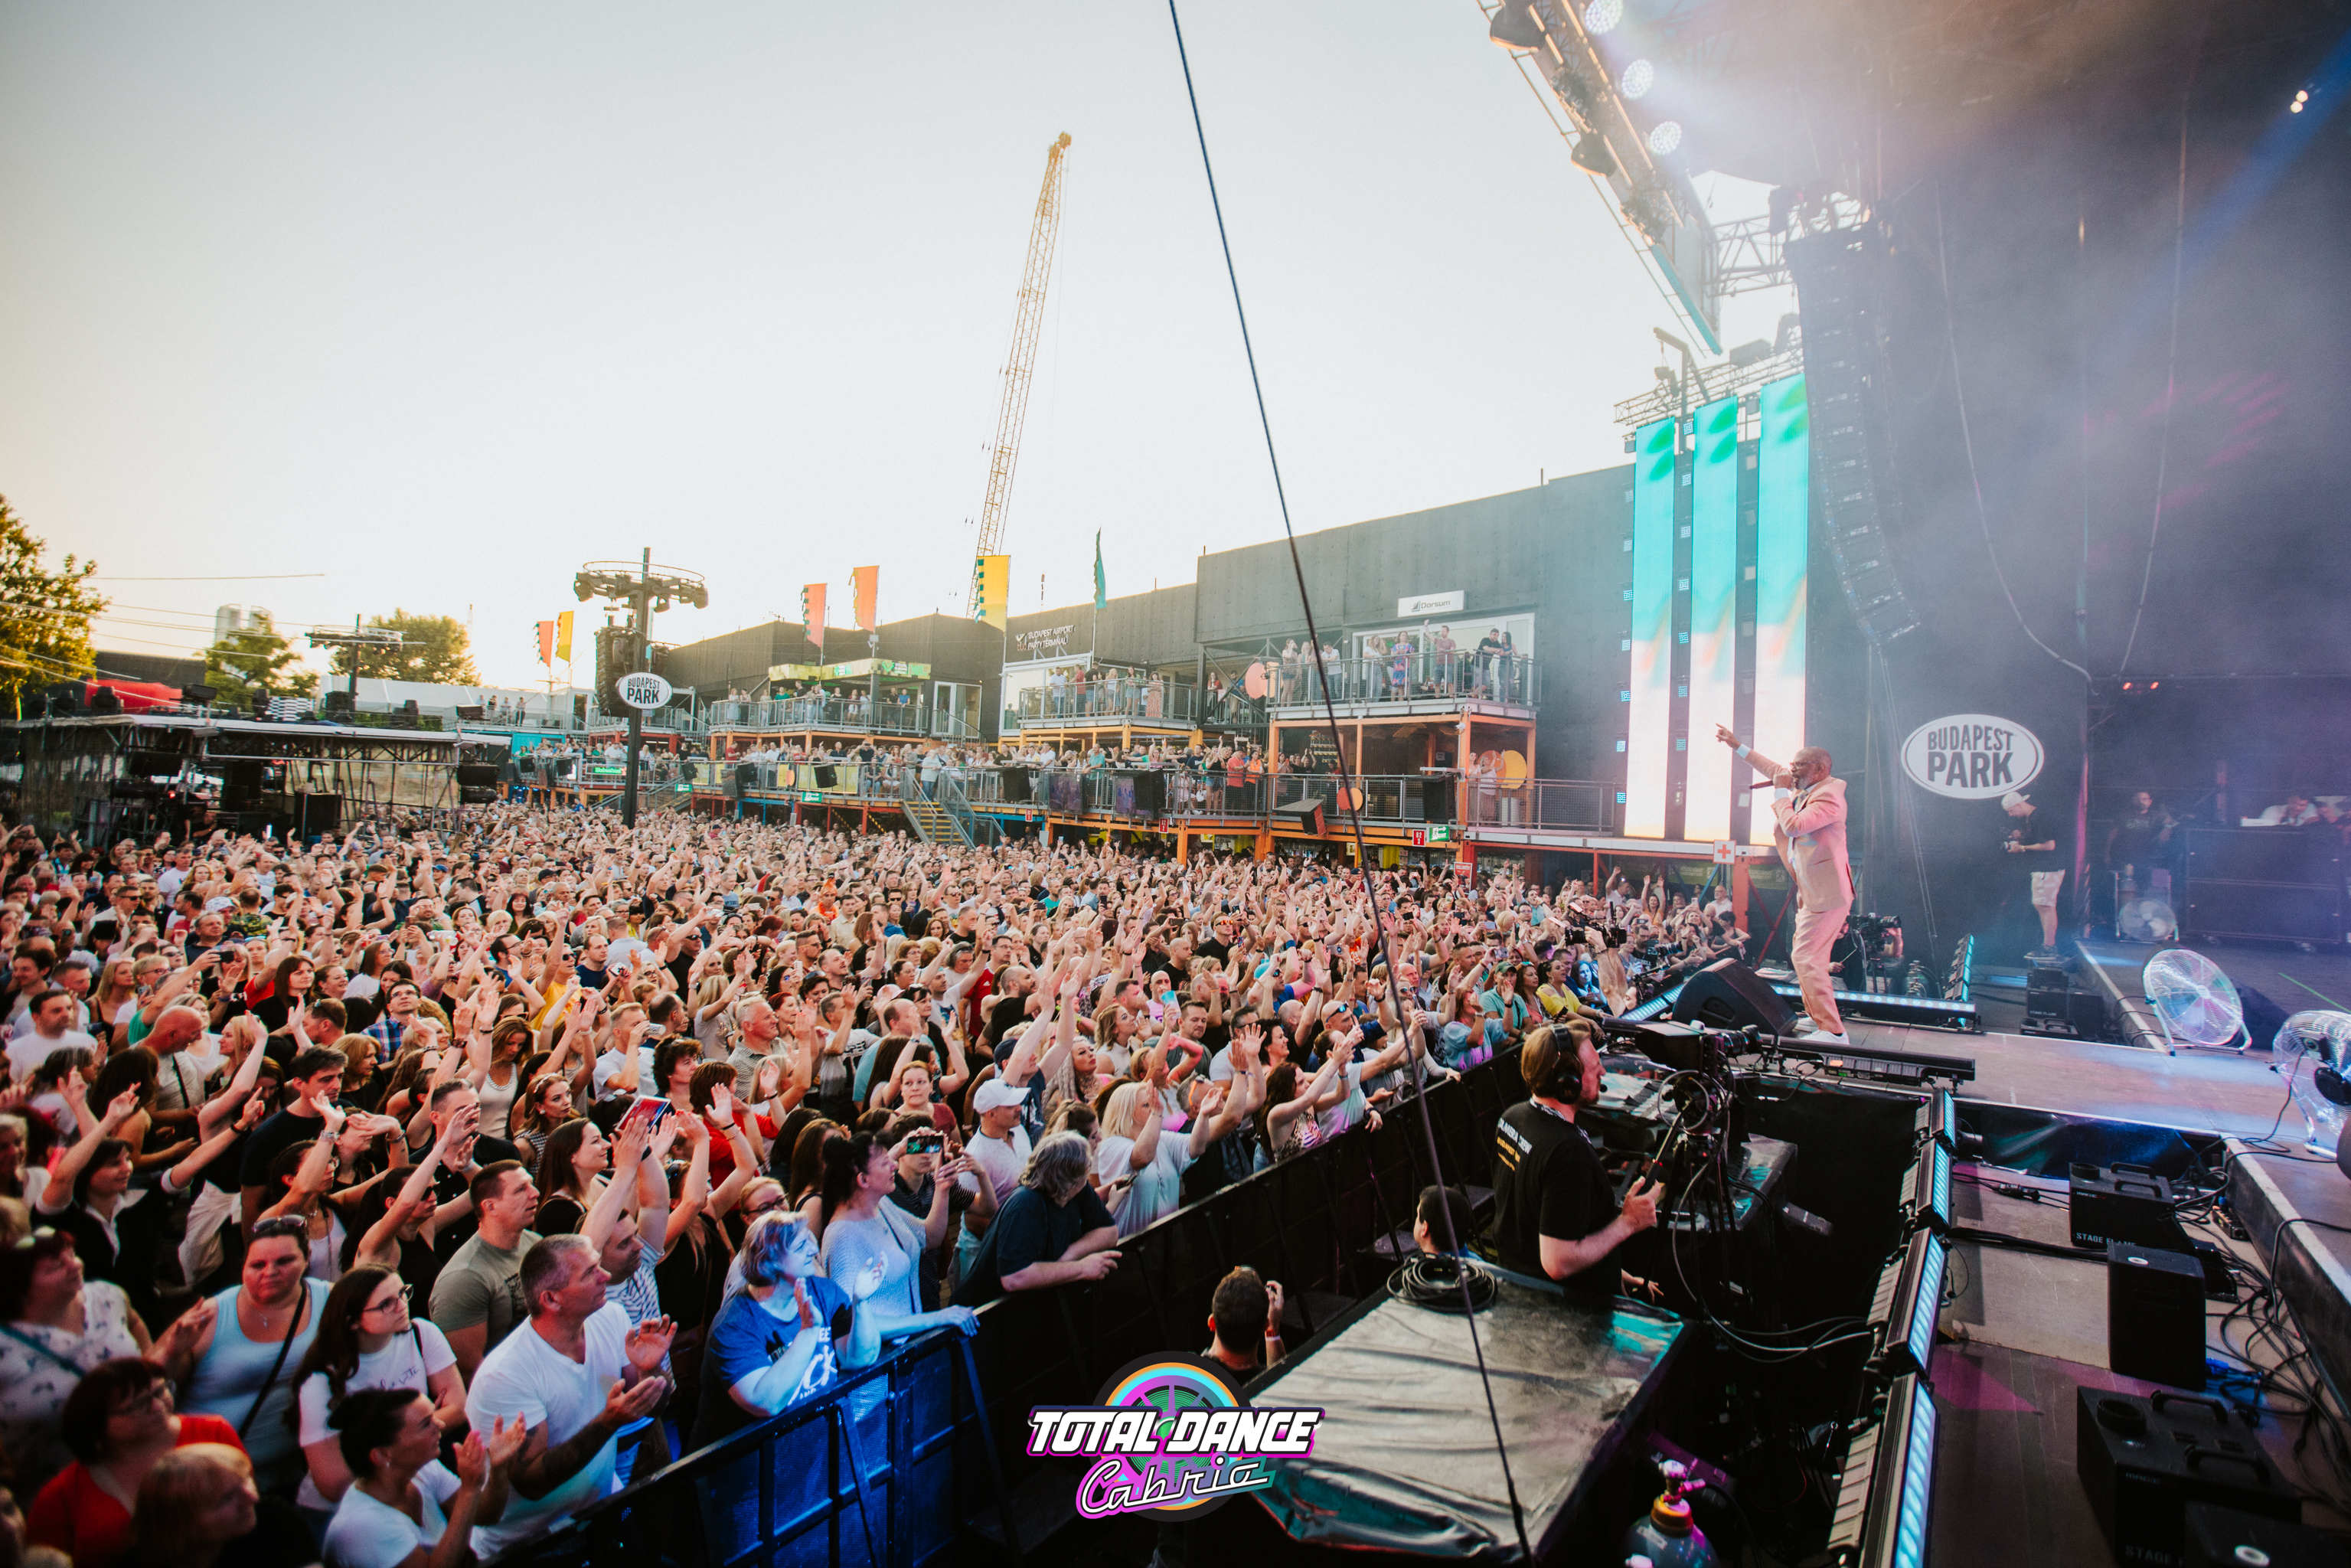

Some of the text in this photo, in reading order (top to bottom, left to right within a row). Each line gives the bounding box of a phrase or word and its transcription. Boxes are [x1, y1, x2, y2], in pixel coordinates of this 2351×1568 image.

[1421, 600, 1451, 609] Dorsum
[1027, 625, 1074, 640] BUDAPEST AIRPORT
[1027, 637, 1067, 650] PARTY TERMINAL
[628, 677, 661, 689] BUDAPEST
[627, 688, 660, 704] PARK
[1928, 724, 2013, 750] BUDAPEST
[1928, 751, 2013, 788] PARK
[2076, 1232, 2103, 1243] STAGE
